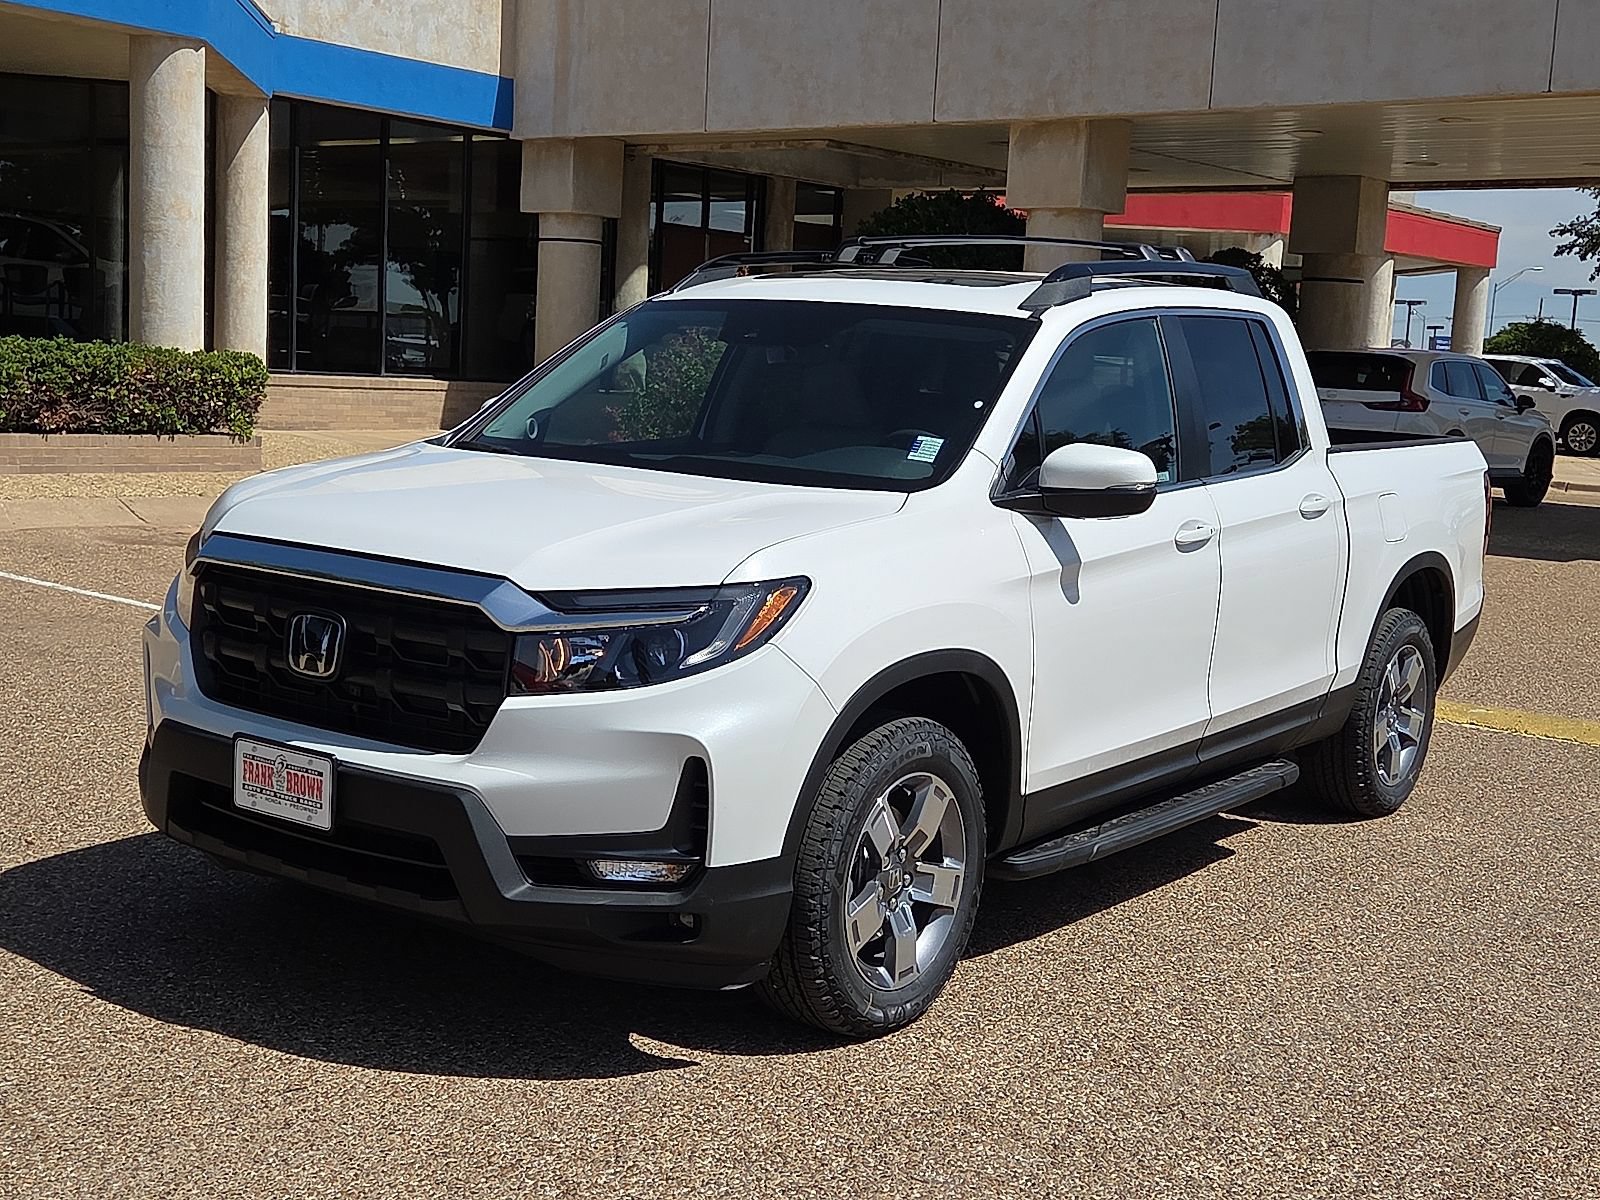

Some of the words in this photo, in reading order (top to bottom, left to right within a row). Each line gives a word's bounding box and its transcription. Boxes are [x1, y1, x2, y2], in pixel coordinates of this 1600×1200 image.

[243, 760, 274, 788] FRANK
[286, 772, 323, 801] BROWN
[244, 784, 260, 792] AUTO
[276, 793, 297, 802] TRUCK
[299, 799, 320, 808] RANCH
